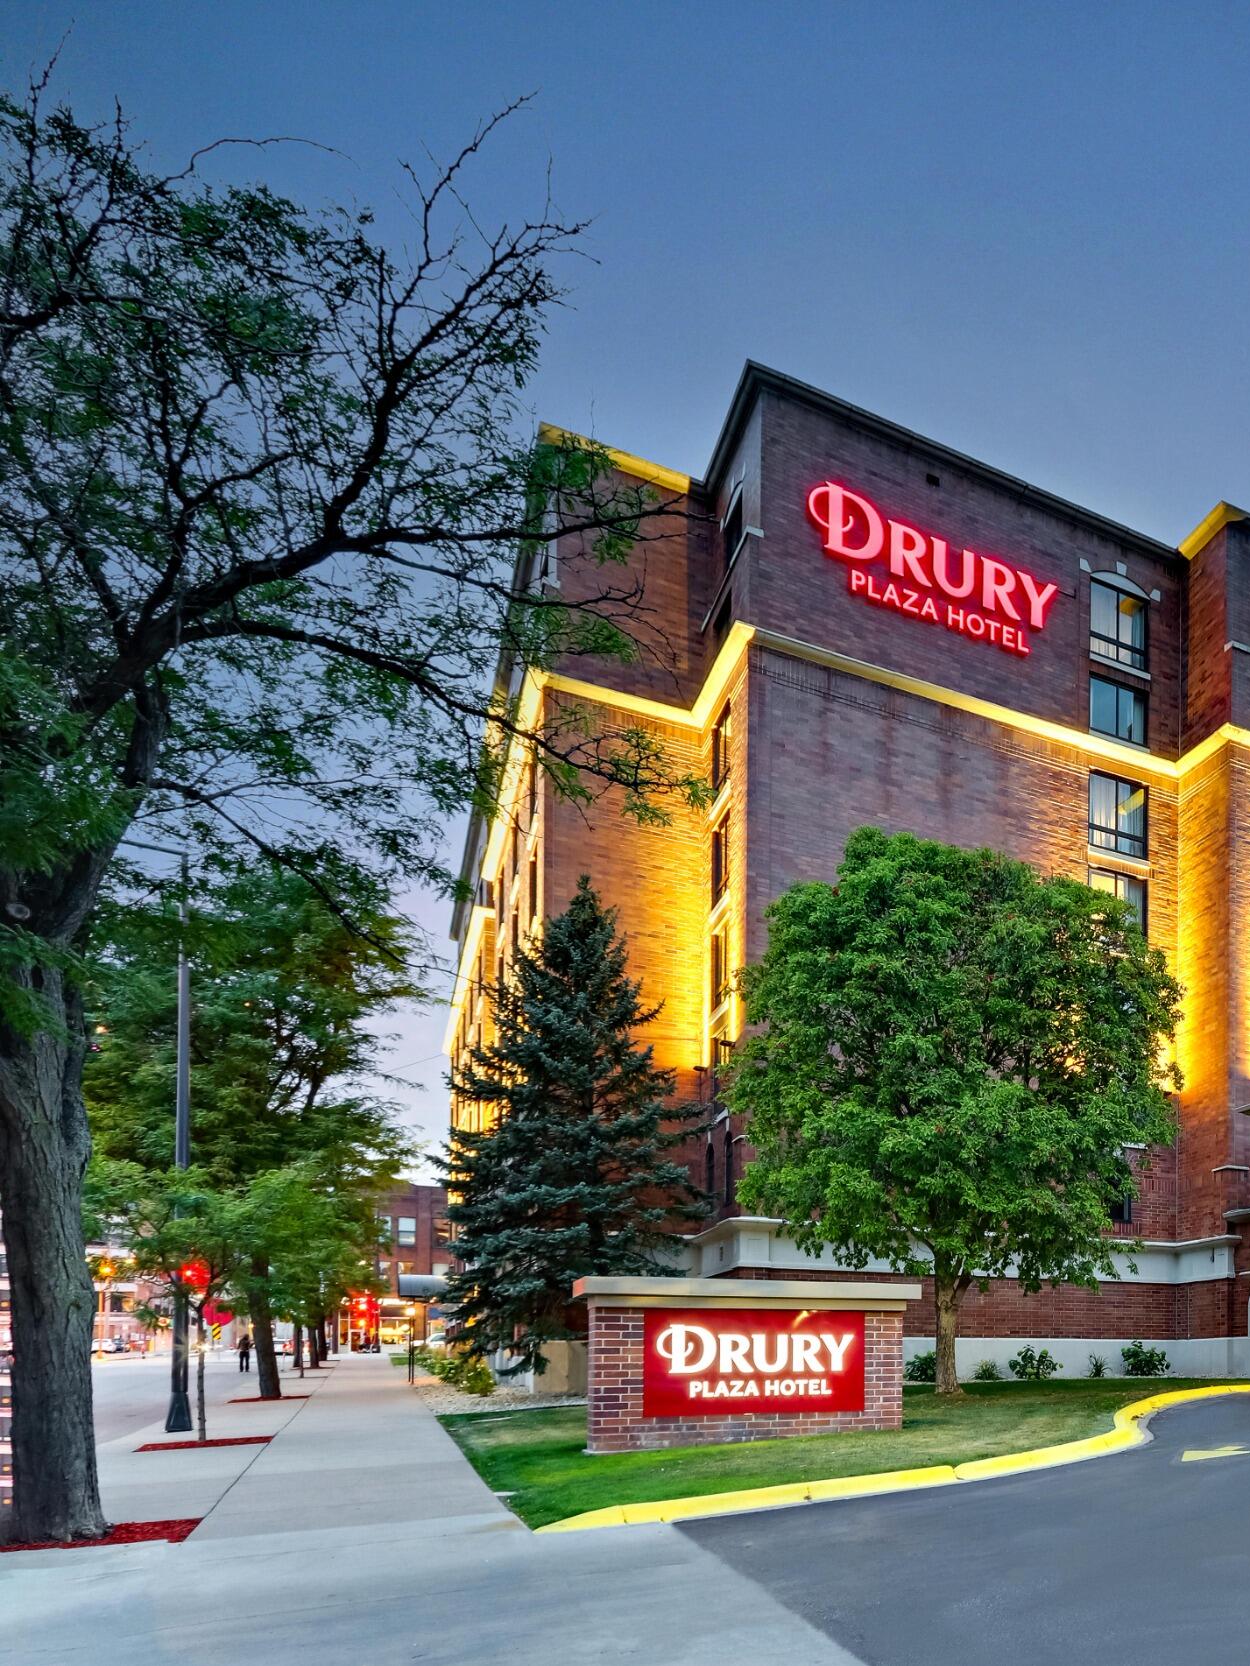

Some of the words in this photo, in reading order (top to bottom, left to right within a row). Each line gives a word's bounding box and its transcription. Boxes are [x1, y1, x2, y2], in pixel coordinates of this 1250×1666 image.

[808, 480, 1058, 629] DRURY
[851, 569, 939, 621] PLAZA
[947, 605, 1030, 653] HOTEL
[656, 1324, 855, 1374] DRURY
[689, 1379, 759, 1399] PLAZA
[765, 1379, 832, 1397] HOTEL
